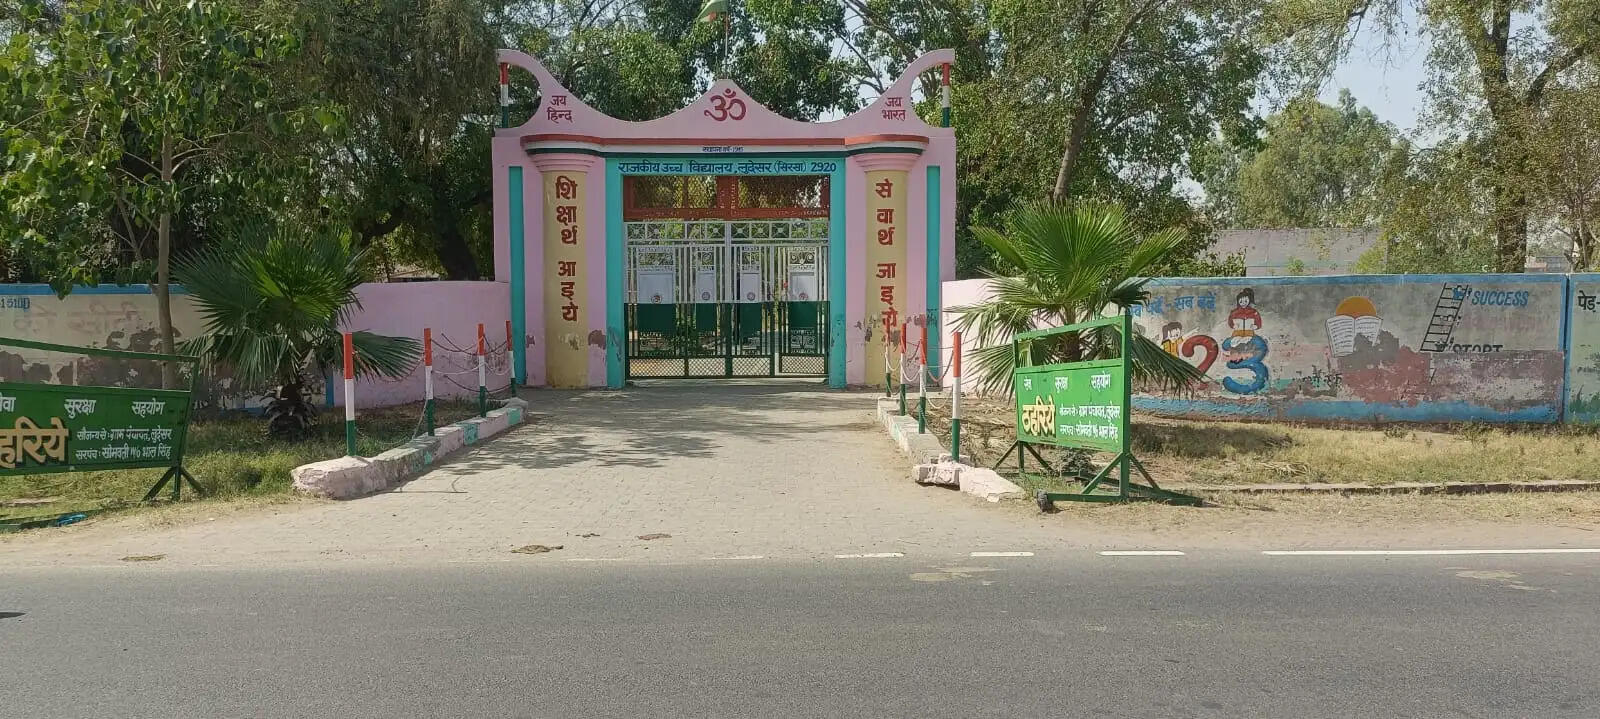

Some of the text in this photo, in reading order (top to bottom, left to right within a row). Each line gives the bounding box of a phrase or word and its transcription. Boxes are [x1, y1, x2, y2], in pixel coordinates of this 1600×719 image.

[550, 95, 567, 106] जय
[885, 97, 902, 107] जय
[547, 106, 573, 123] हिन्द
[882, 109, 906, 121] भारत
[618, 159, 660, 173] राजकीय
[662, 162, 682, 173] उच्च
[689, 159, 732, 174] विद्यालय
[811, 162, 836, 172] 2920
[875, 178, 896, 246] सेवार्थ
[557, 260, 578, 322] आइये
[1472, 290, 1529, 307] SUCCESS
[64, 398, 97, 419] सुरक्षा
[131, 397, 165, 418] सहयोग
[1022, 395, 1056, 437] ठहरिये
